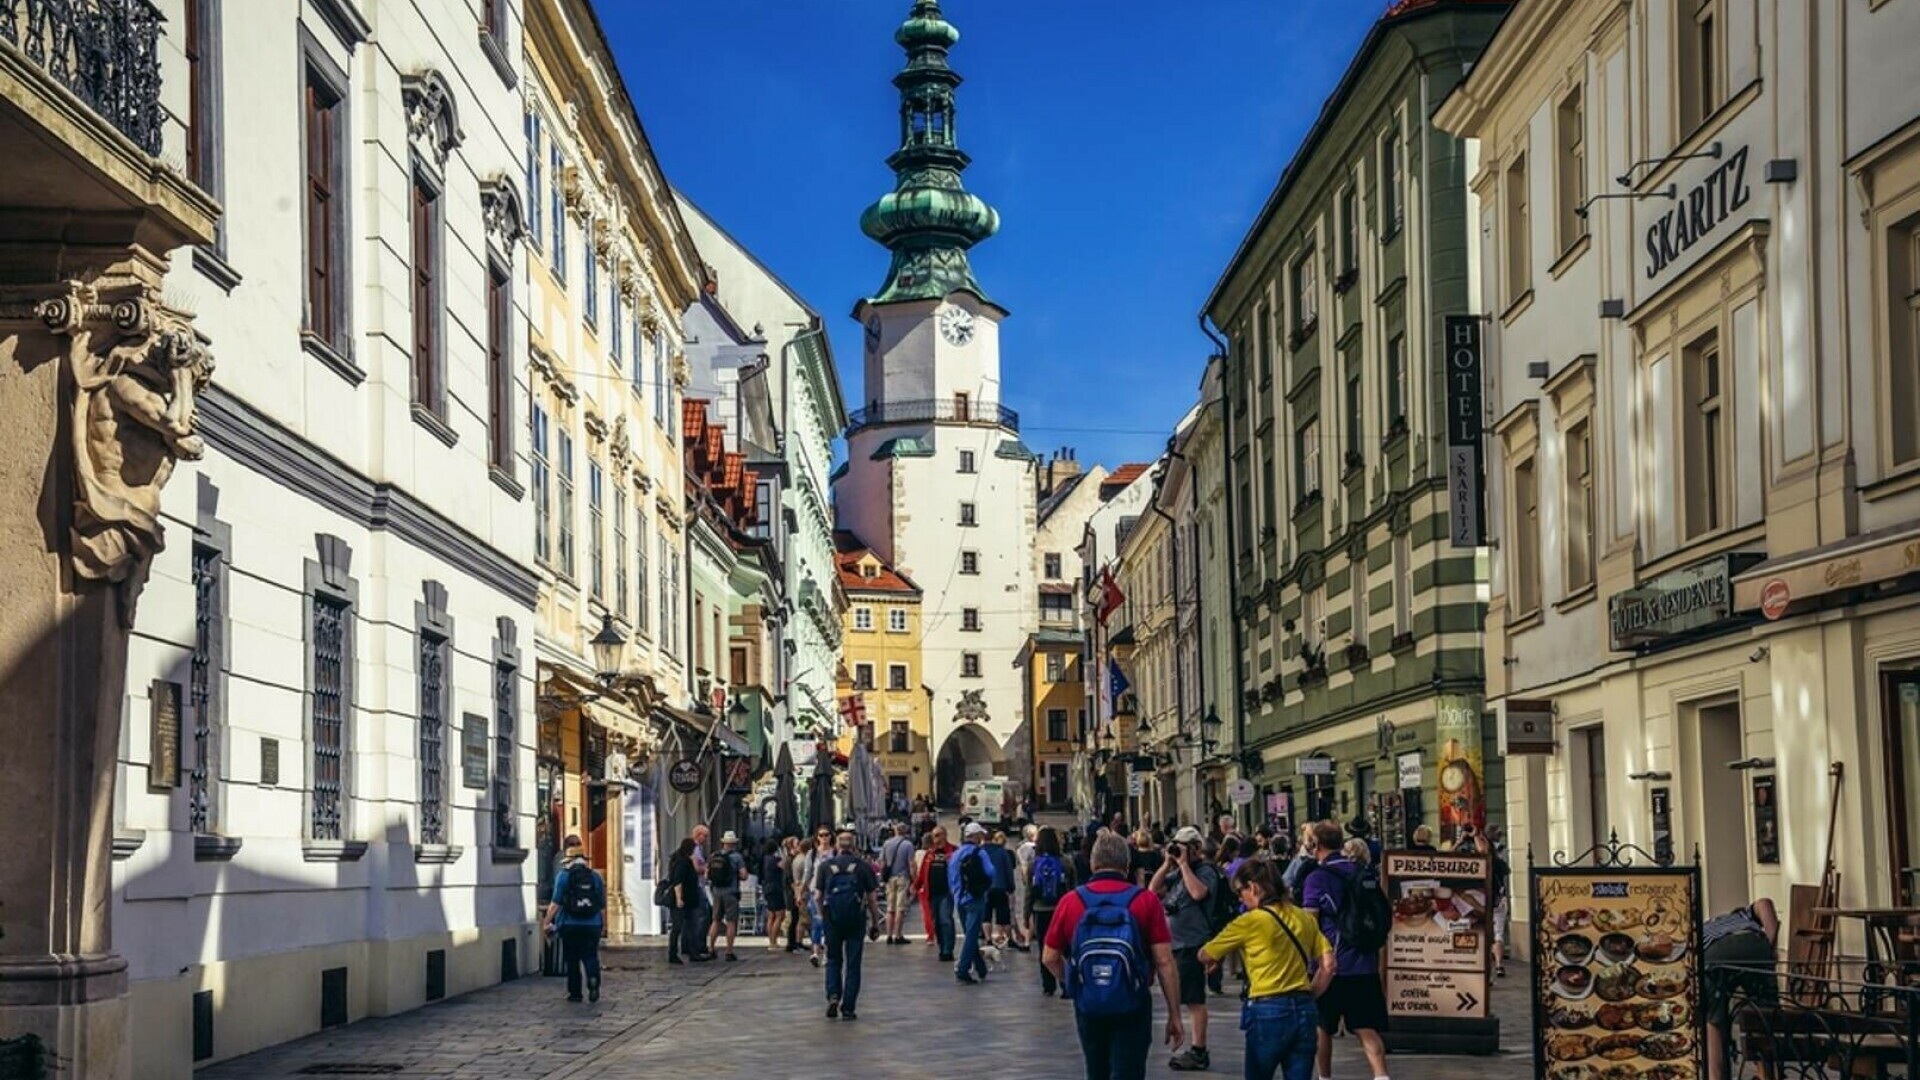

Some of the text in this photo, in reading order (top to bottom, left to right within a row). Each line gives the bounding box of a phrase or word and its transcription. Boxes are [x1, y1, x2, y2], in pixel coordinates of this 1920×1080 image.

[1647, 144, 1750, 279] SKARITZ
[1453, 325, 1475, 441] HOTEL
[1456, 452, 1470, 542] SKARITZ
[1658, 574, 1727, 621] RESIDENCE
